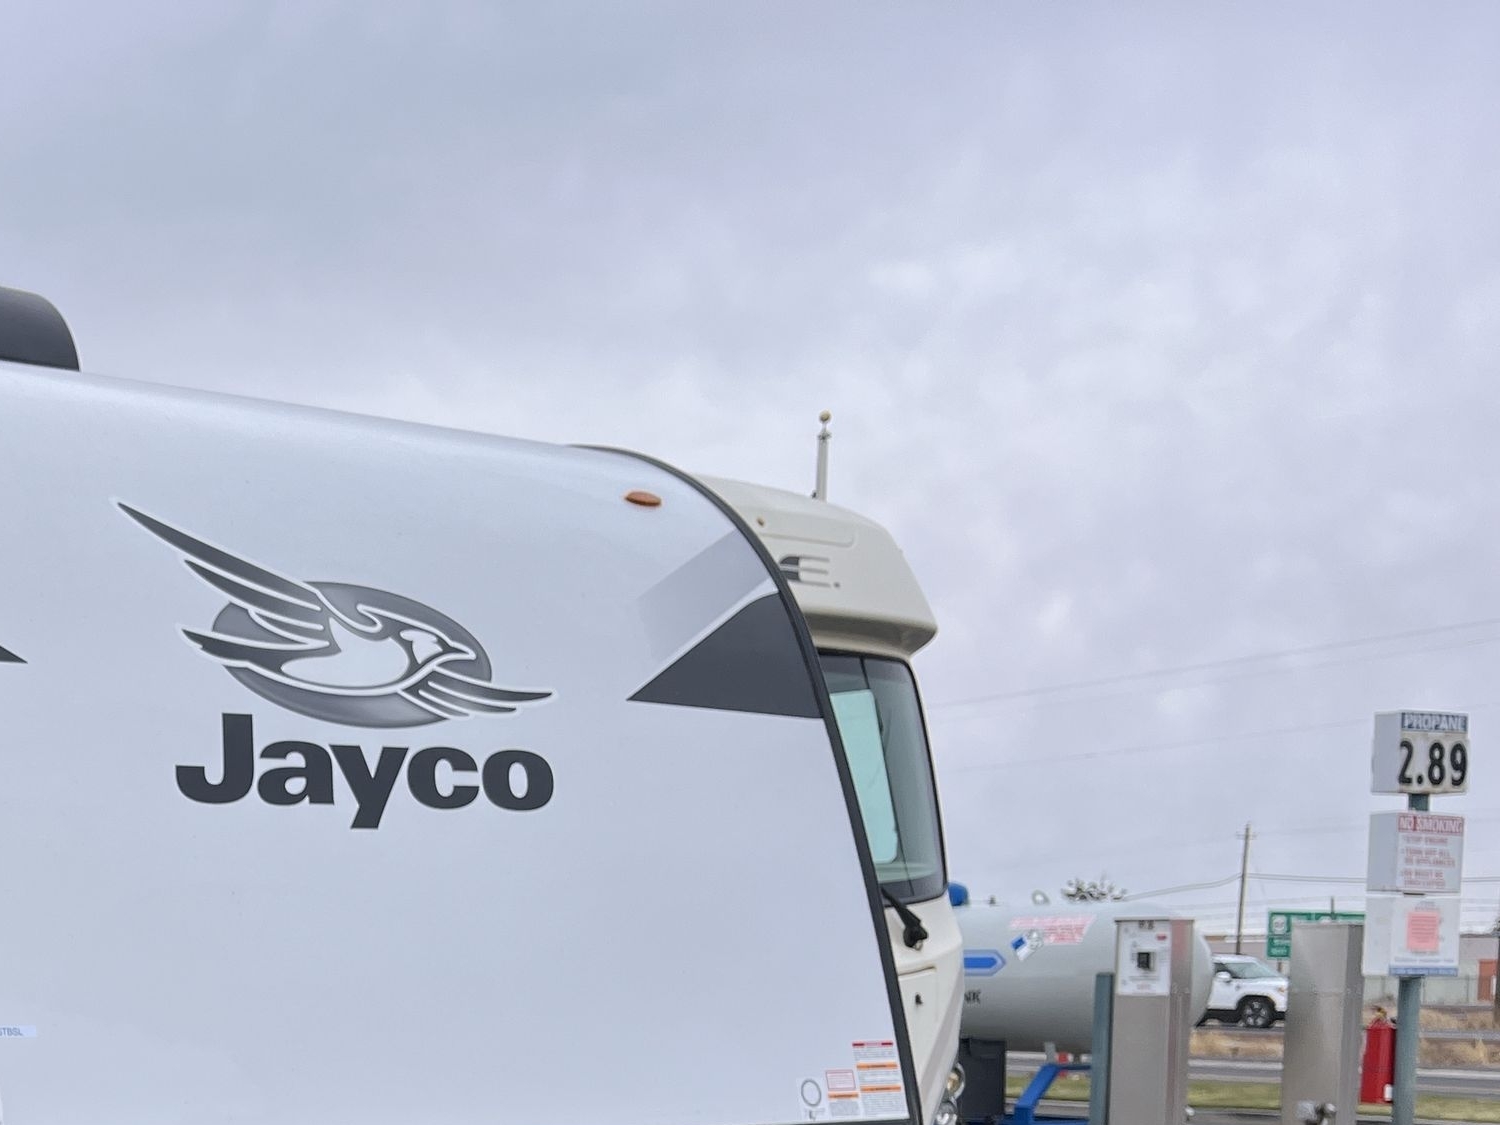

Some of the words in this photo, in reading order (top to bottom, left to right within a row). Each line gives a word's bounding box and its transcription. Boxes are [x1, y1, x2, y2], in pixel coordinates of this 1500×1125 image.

[1403, 713, 1467, 732] PROPANE
[175, 712, 554, 829] Jayco
[1398, 740, 1468, 787] 2.89
[1400, 816, 1413, 831] NO
[1416, 818, 1463, 835] SMOKING
